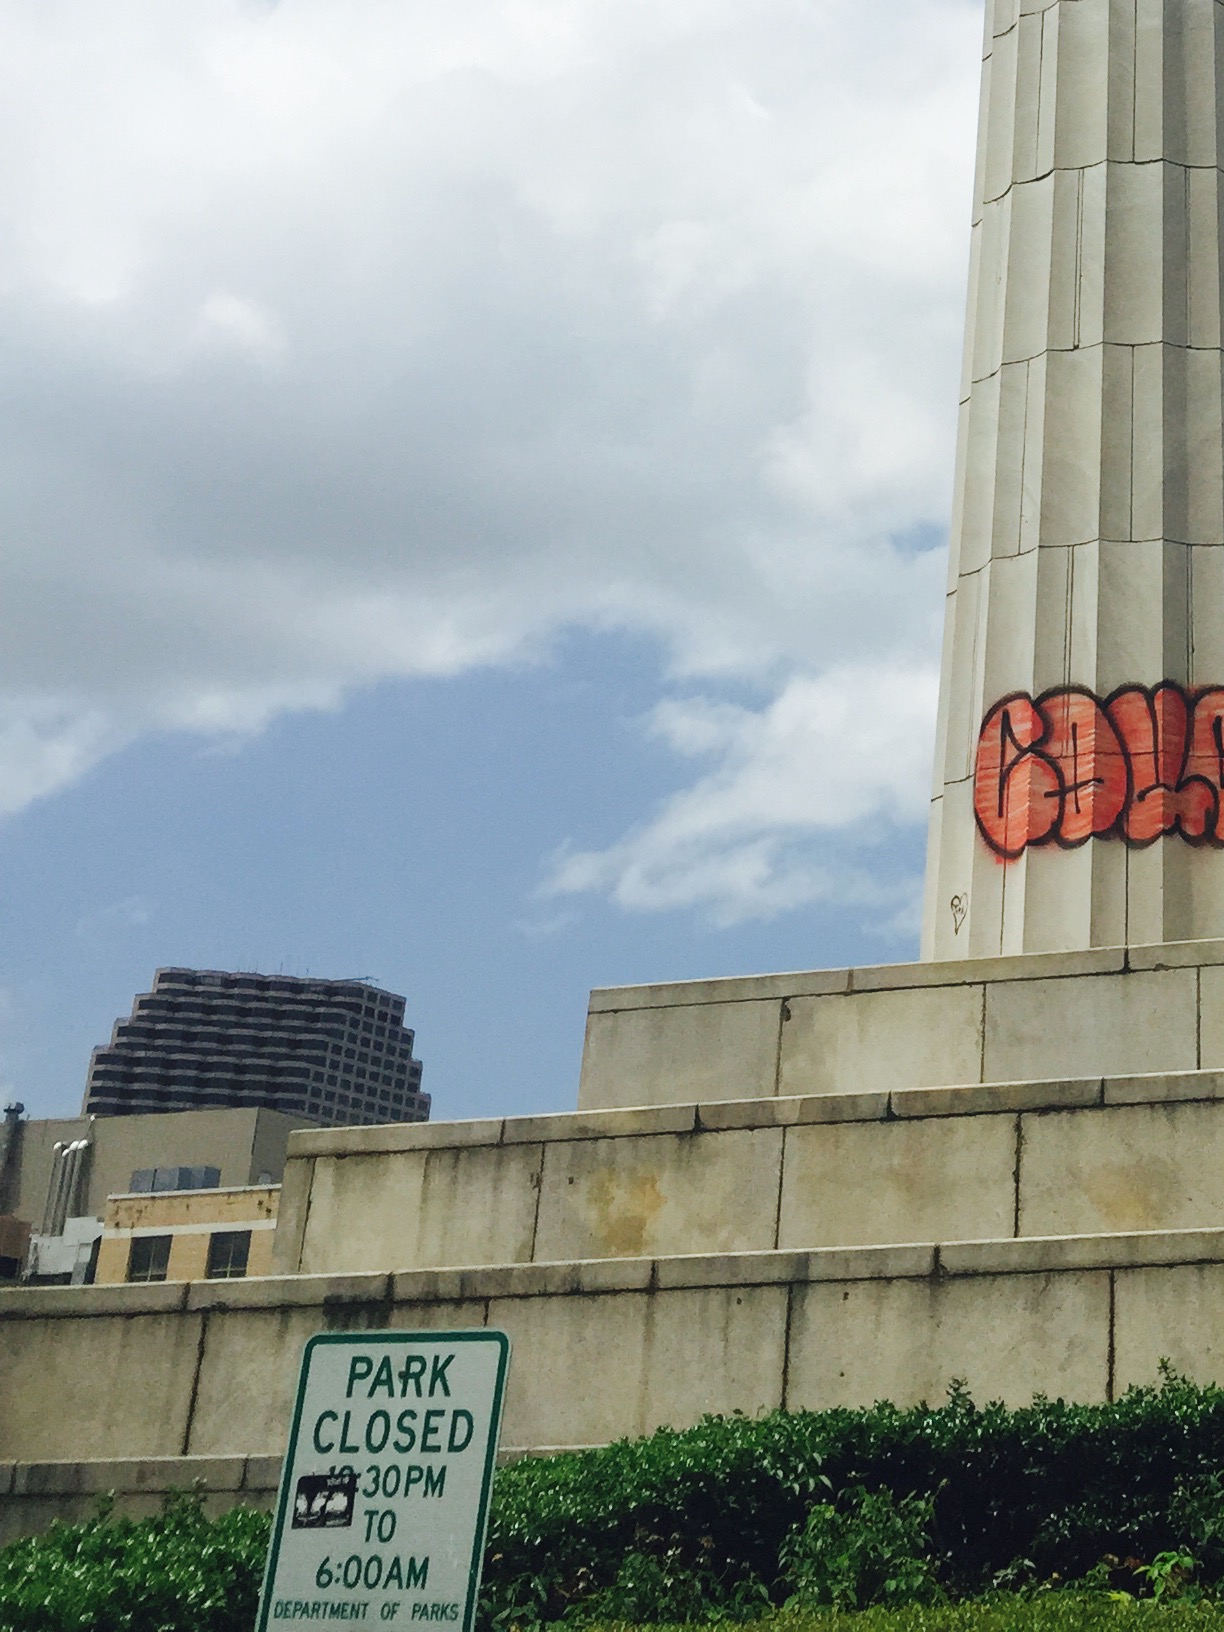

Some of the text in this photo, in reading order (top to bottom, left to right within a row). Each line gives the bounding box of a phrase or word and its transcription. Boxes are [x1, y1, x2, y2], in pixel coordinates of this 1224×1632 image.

[346, 1354, 456, 1399] PARK
[313, 1409, 474, 1454] CLOSED
[364, 1510, 397, 1543] TO
[315, 1554, 430, 1590] 6:00AM
[273, 1600, 460, 1621] DEPARTMENT OF PARKS
